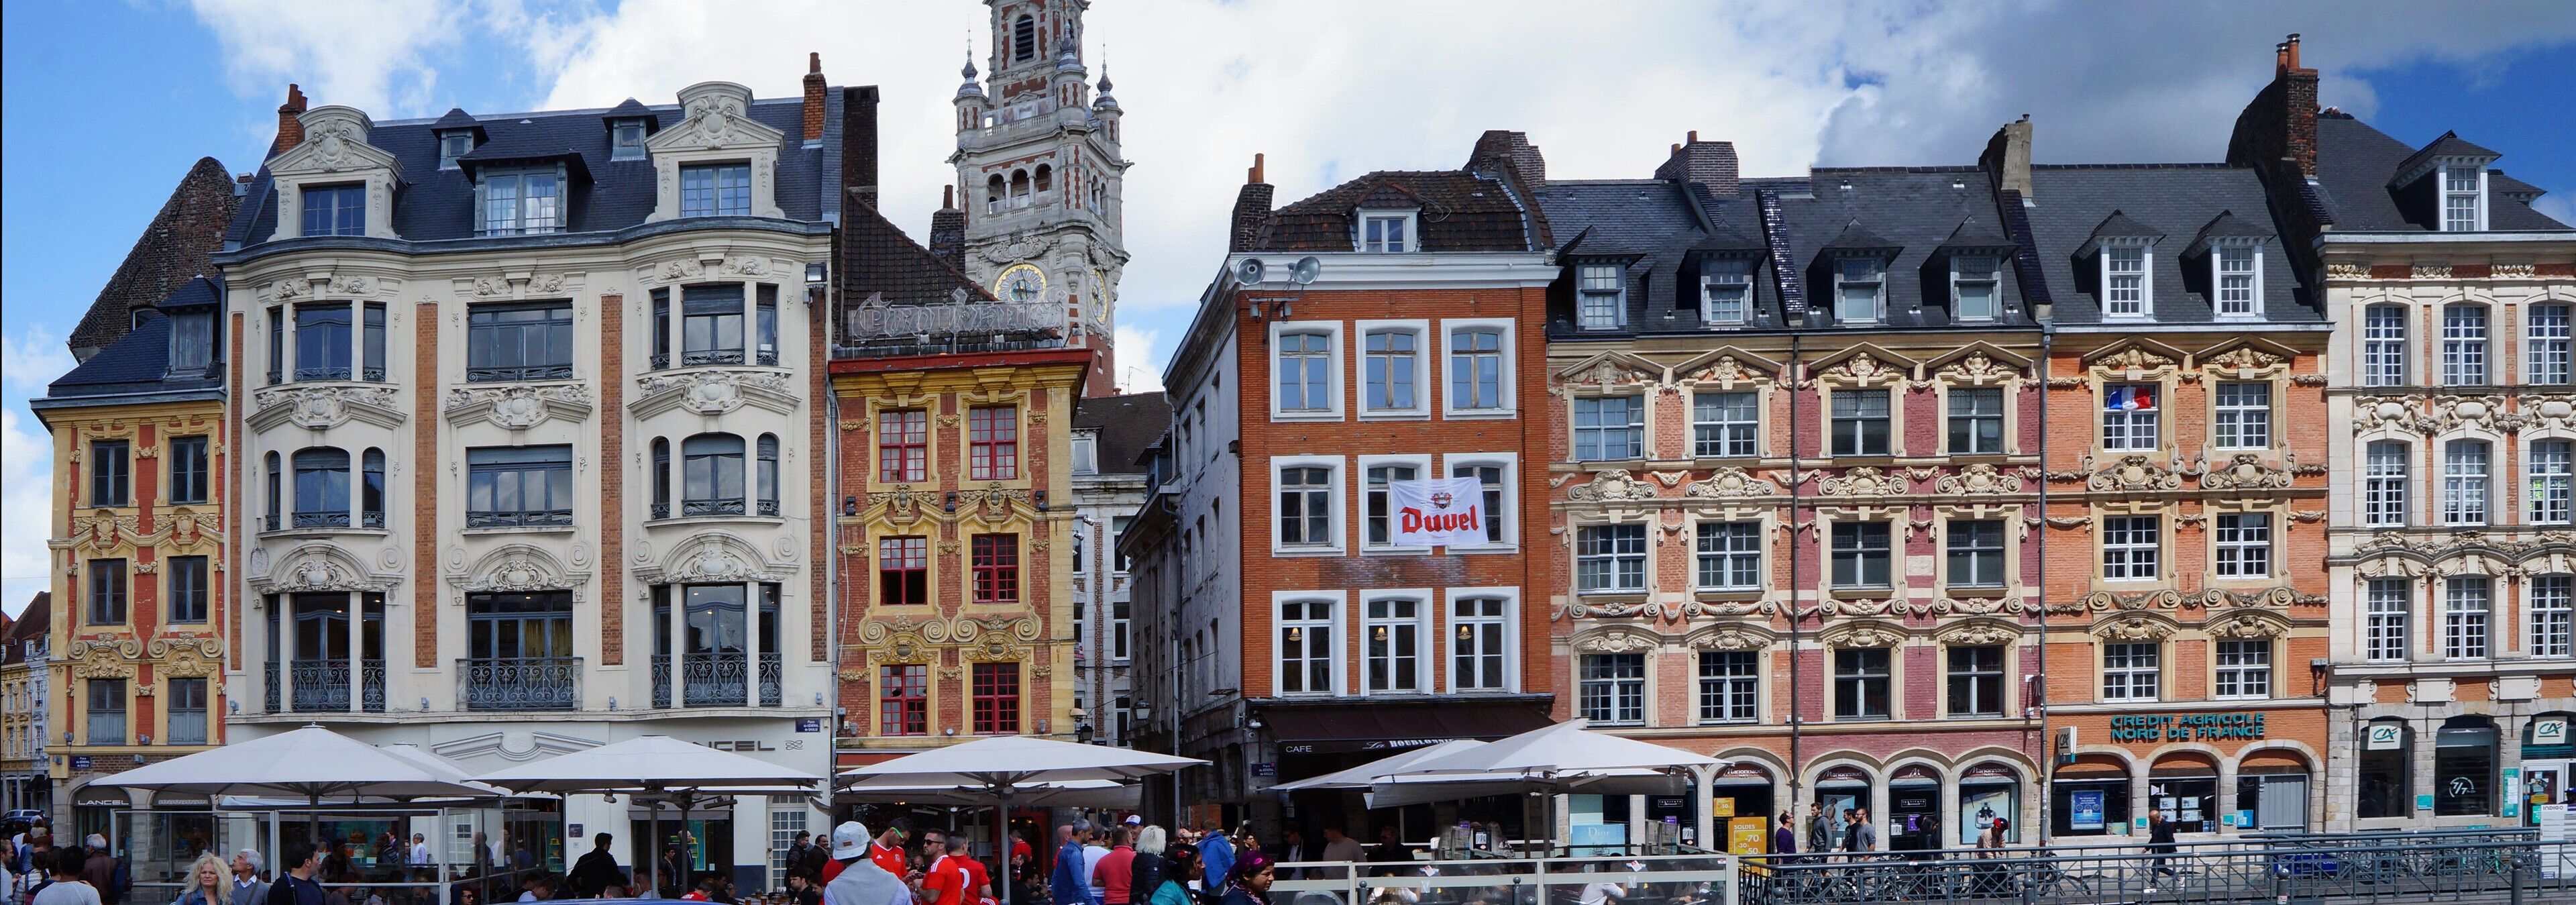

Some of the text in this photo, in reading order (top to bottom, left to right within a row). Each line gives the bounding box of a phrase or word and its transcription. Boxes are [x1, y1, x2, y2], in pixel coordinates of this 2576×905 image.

[1399, 504, 1479, 534] Duvel
[2112, 712, 2265, 727] CREDIT AGRICOLE
[2111, 725, 2265, 739] NORD DE FRANCE
[1362, 741, 1385, 749] La
[1723, 767, 1763, 776] Marionnaud
[1822, 770, 1862, 779] Marionnaud
[1969, 766, 2008, 774] Marionnaud
[1588, 827, 1610, 837] Dior
